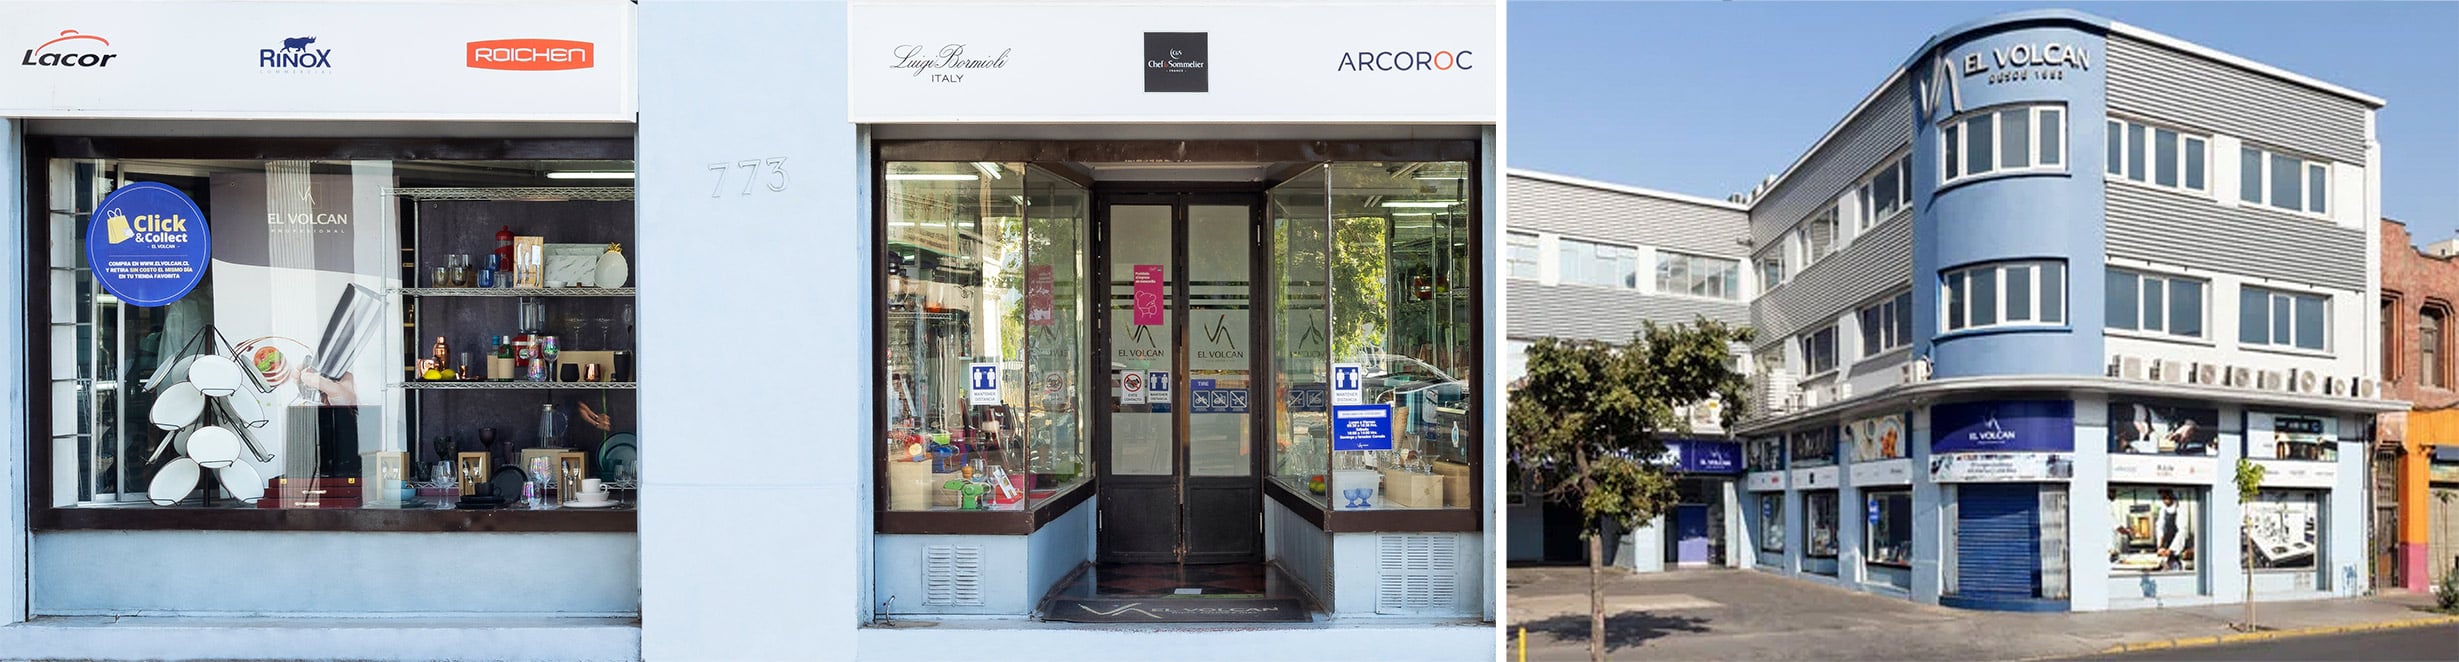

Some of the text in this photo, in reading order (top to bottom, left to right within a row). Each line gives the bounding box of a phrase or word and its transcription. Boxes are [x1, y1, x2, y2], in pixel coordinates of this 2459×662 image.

[22, 49, 117, 67] Lacor
[260, 49, 331, 68] RINOX
[475, 48, 585, 62] ROICHEN
[889, 44, 1011, 77] Luigi Bormioli
[1337, 50, 1473, 71] ARCOROC
[1964, 42, 2091, 78] EL VOLCAN
[931, 74, 964, 82] ITALY
[707, 156, 791, 198] 773
[133, 214, 187, 232] Click
[267, 213, 348, 225] EL VOLCAN
[1118, 349, 1165, 357] EL VOLCAN
[1197, 351, 1244, 359] EL VOLCAN
[1969, 431, 2015, 440] EL VOLCAN
